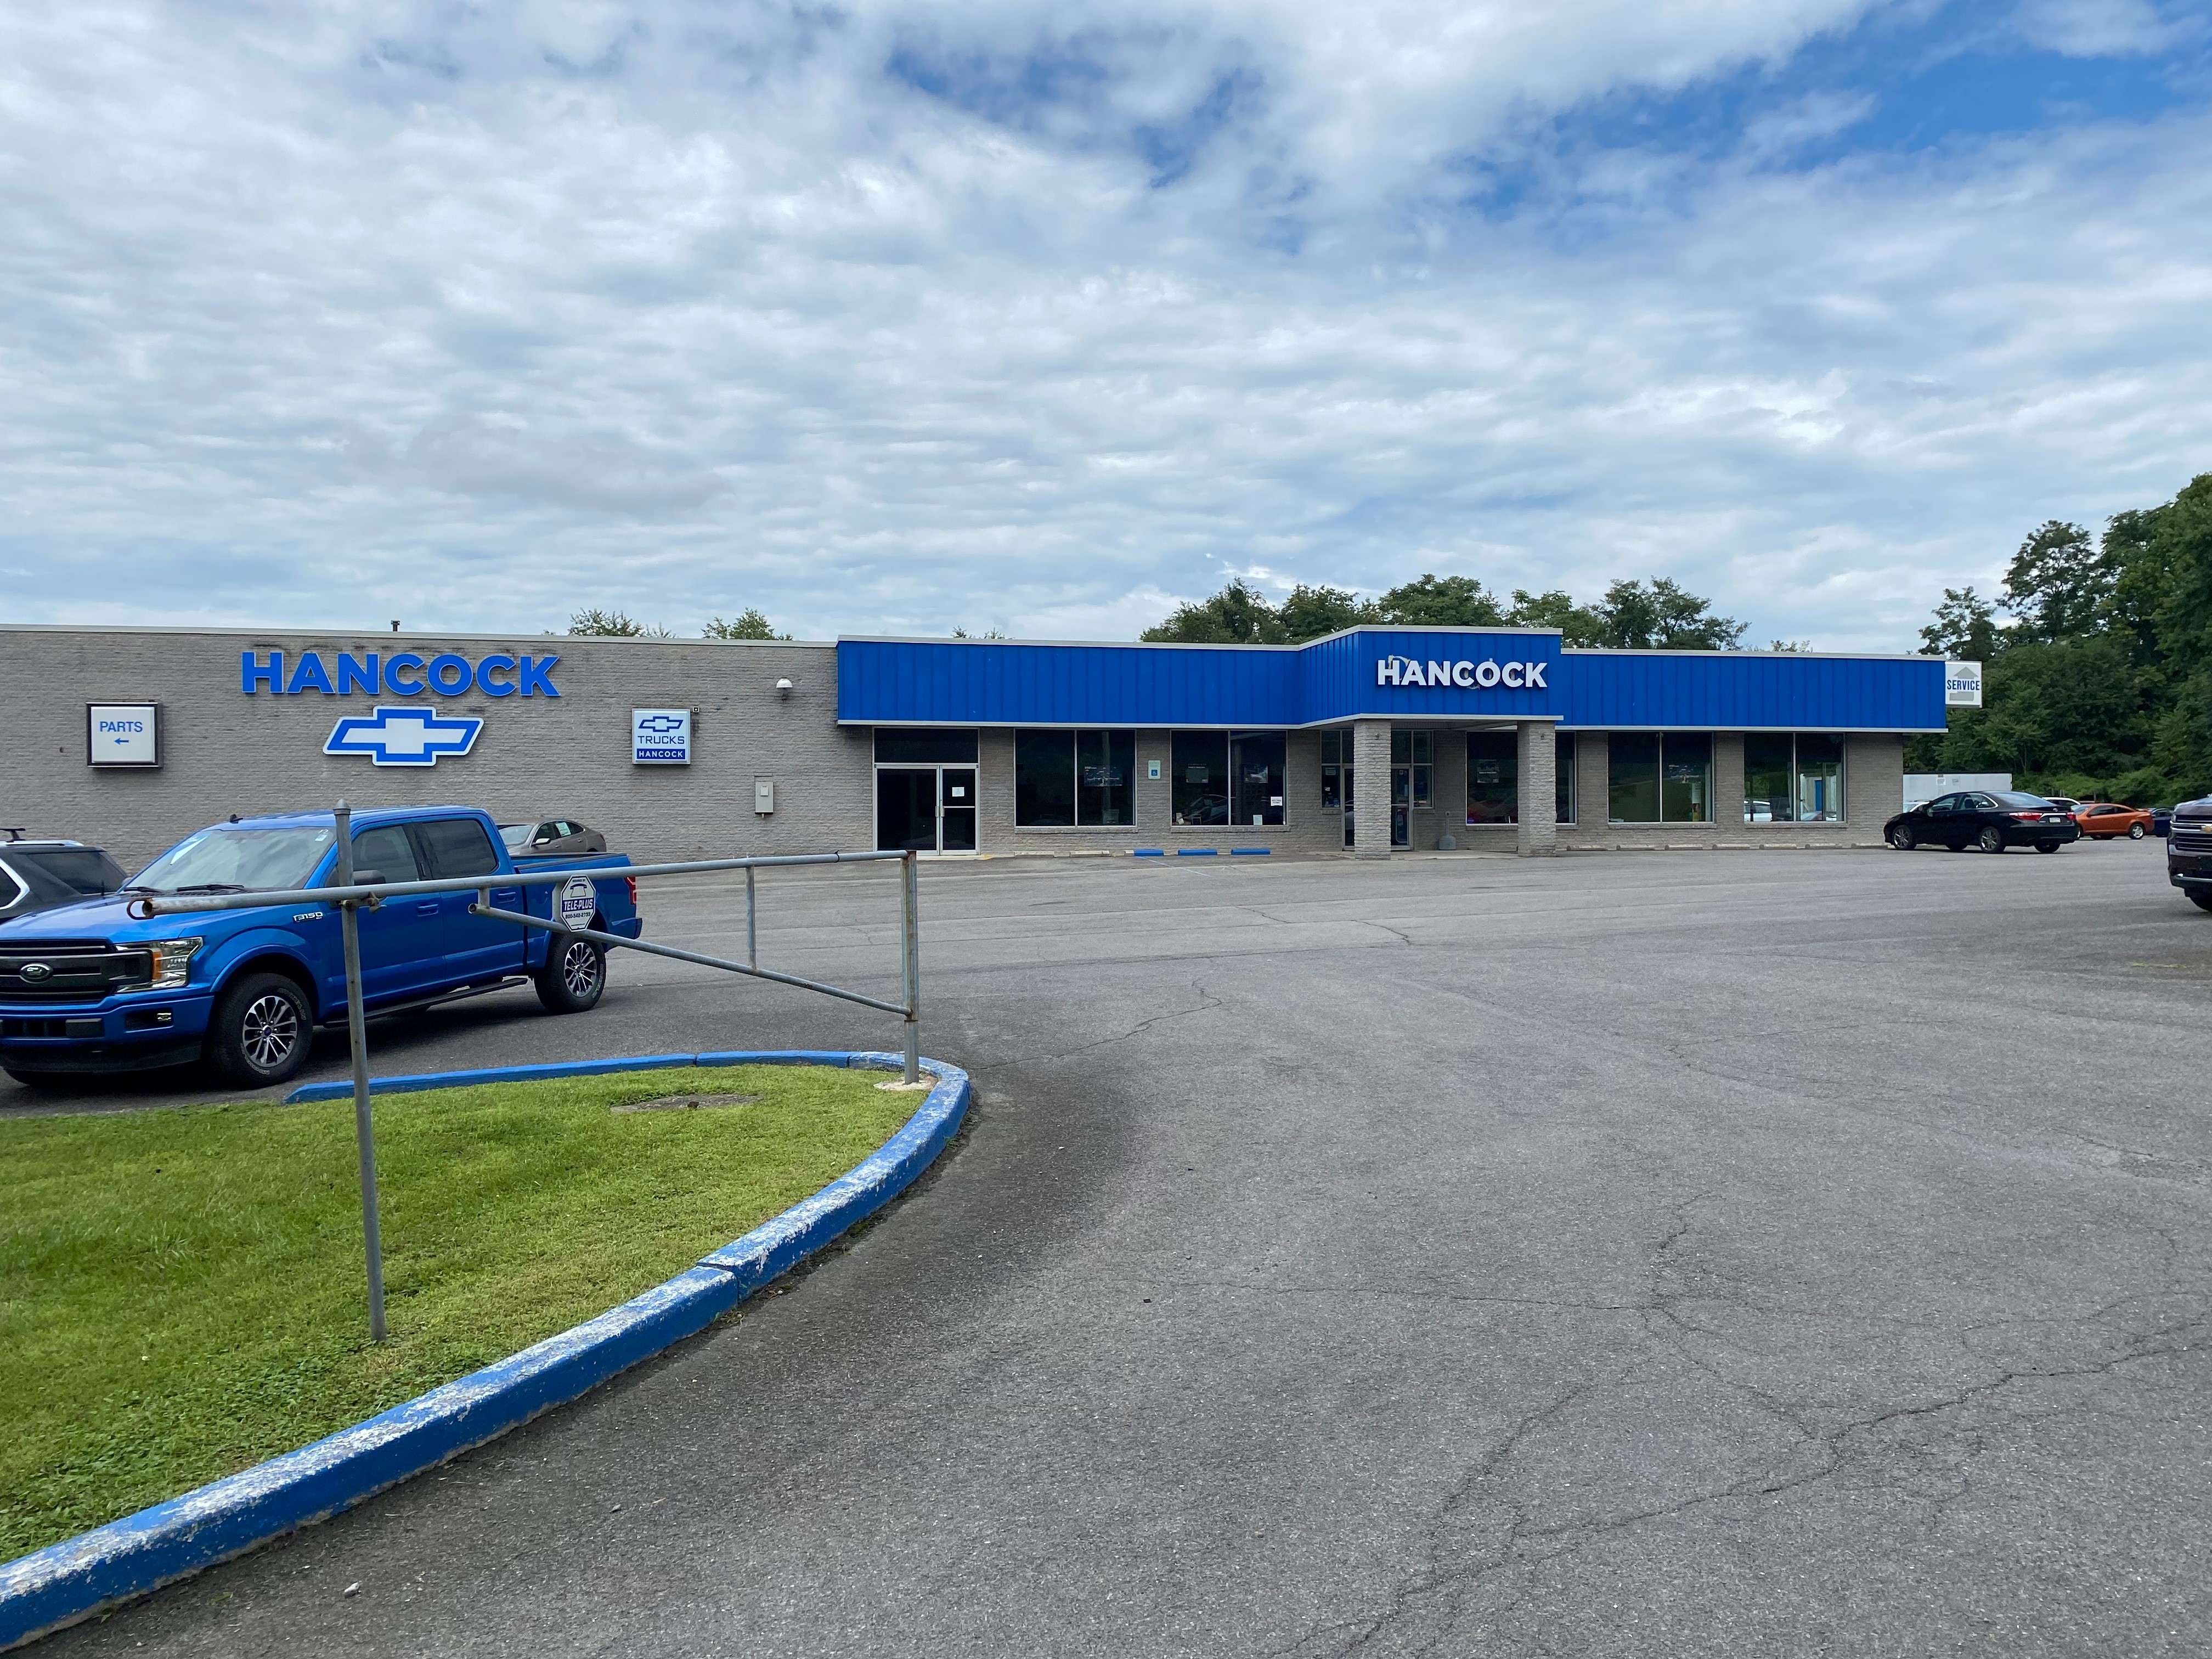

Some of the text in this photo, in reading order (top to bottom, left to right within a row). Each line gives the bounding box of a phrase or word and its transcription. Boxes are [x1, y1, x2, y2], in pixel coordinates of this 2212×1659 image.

[242, 651, 561, 696] HANCOCK
[1378, 659, 1548, 687] HANCOCK
[1947, 679, 1980, 690] SERVICE
[100, 721, 143, 732] PARTS
[637, 736, 685, 744] TRUCKS
[564, 899, 592, 911] TELE-PLUS
